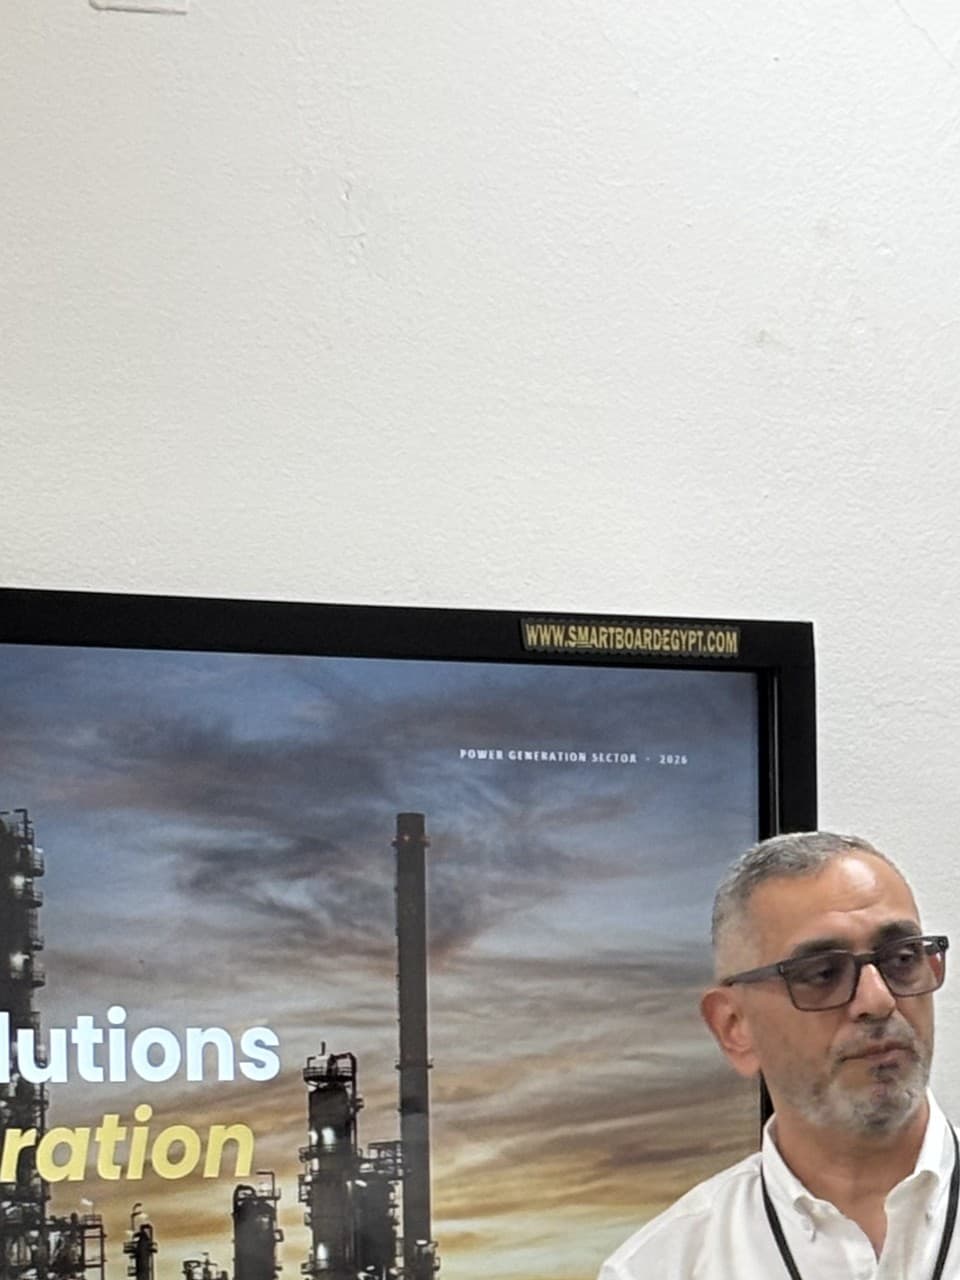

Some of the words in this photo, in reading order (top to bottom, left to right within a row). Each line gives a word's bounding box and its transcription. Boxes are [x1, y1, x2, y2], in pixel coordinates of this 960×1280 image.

[526, 623, 738, 653] WWW.SMARTBOARDEGYPT.COM
[459, 748, 503, 760] POWER
[508, 750, 587, 763] GENERATION
[592, 753, 637, 764] SECTOR
[0, 1104, 254, 1183] ration
